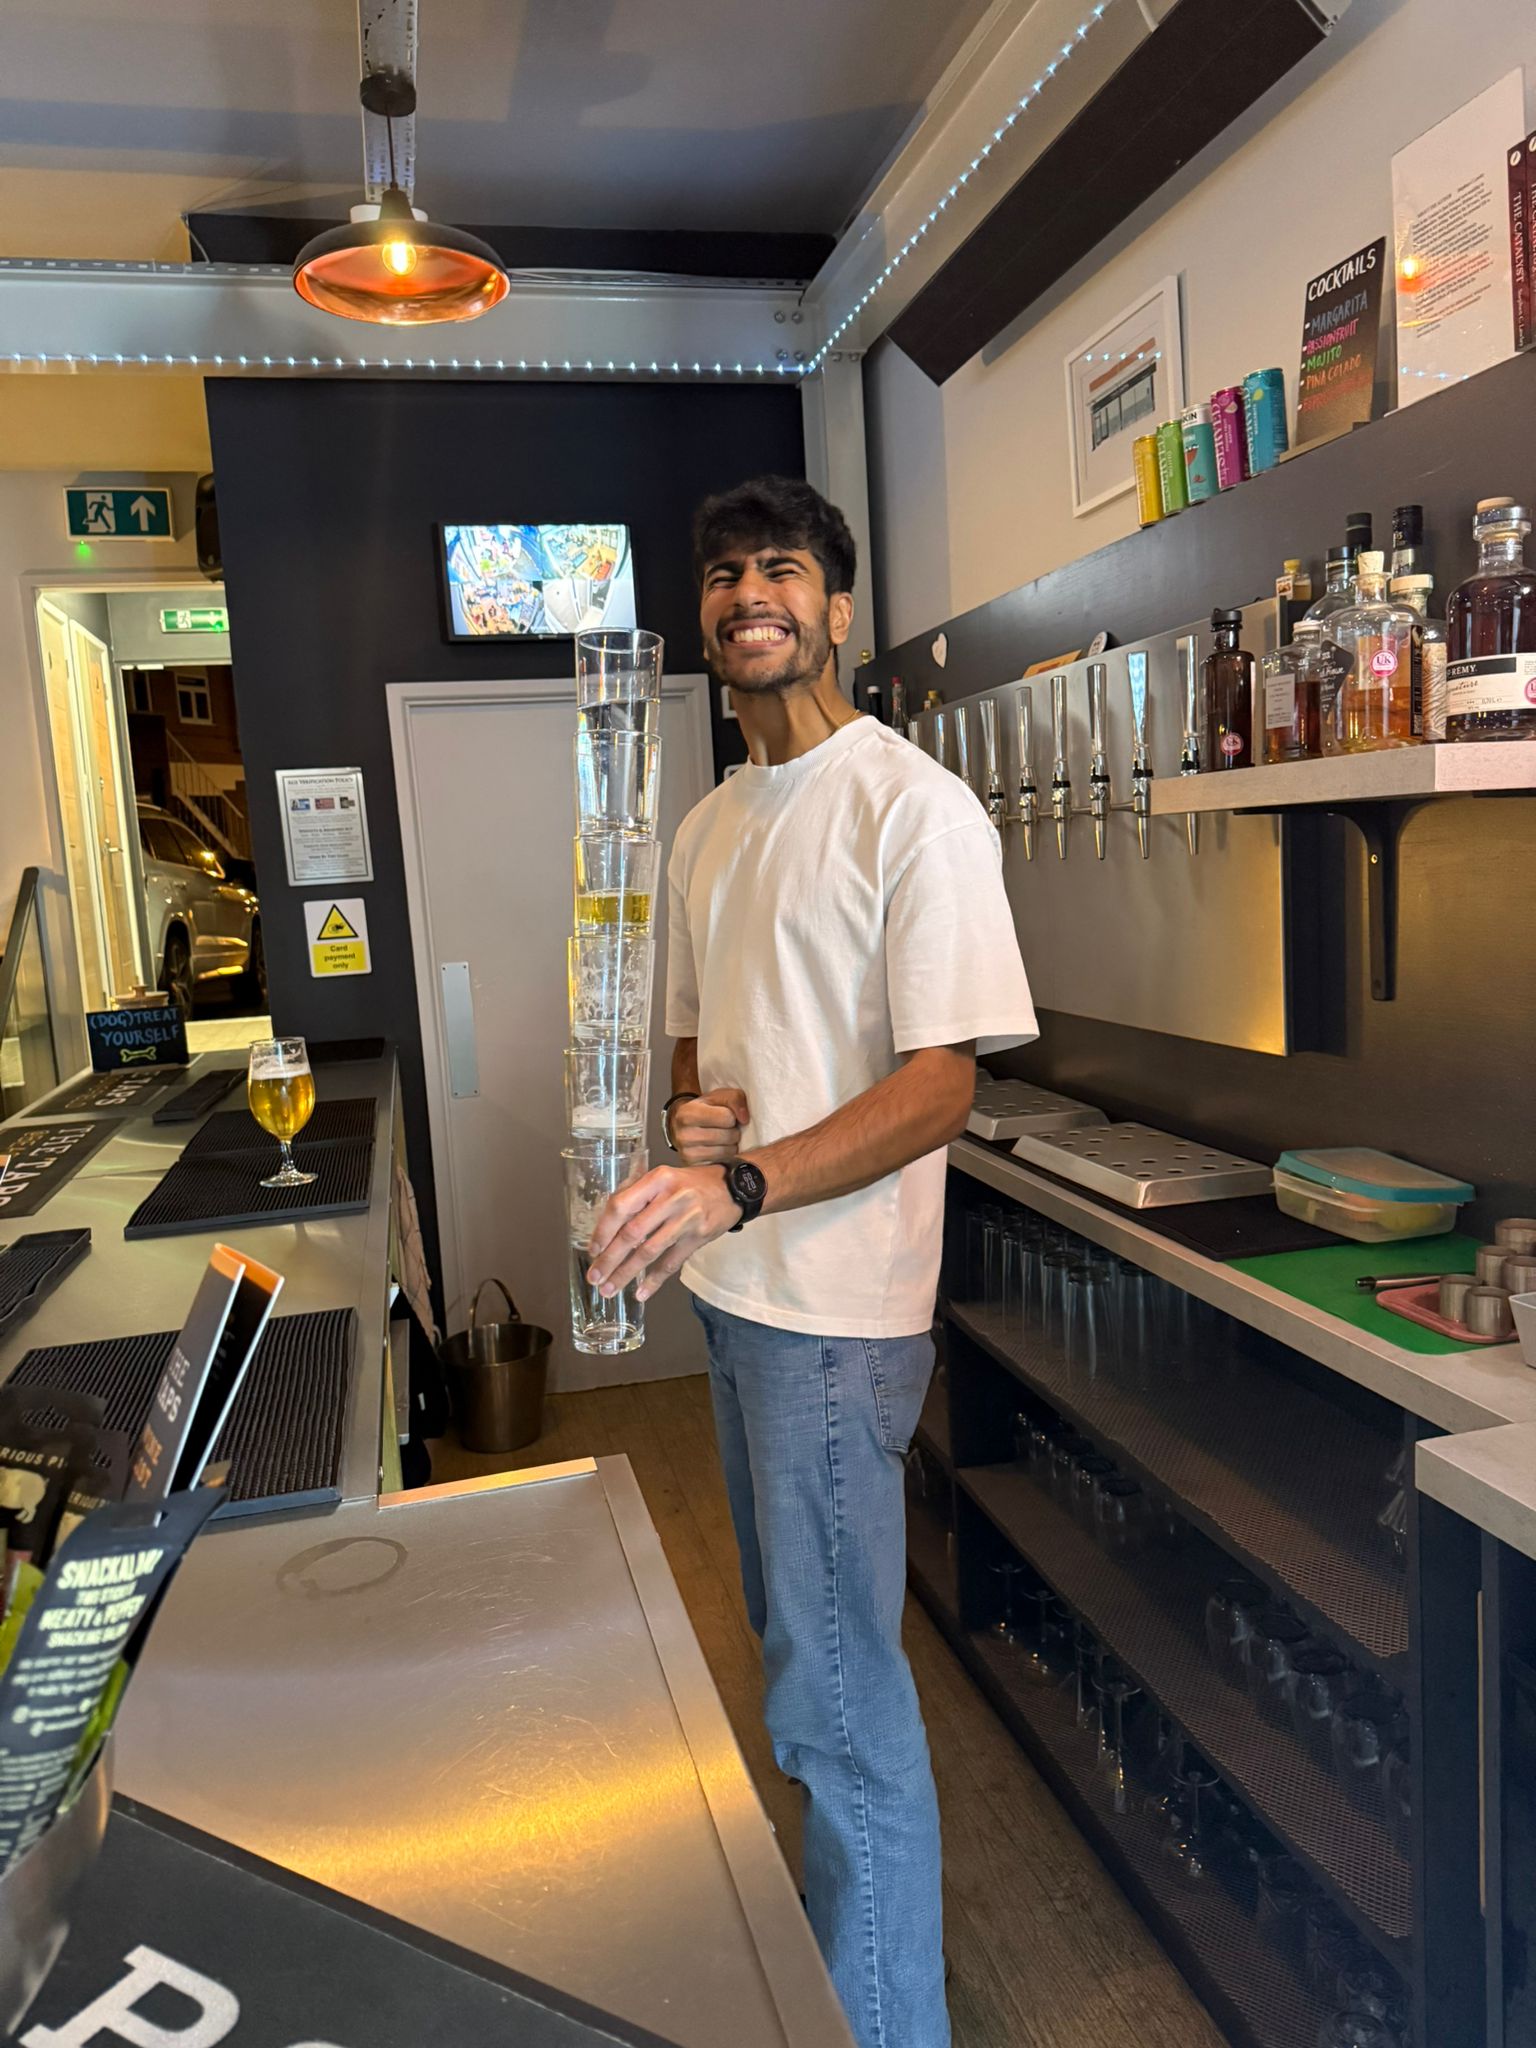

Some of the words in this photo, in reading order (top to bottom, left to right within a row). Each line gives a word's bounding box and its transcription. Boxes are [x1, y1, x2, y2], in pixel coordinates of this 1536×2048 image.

[1512, 192, 1522, 221] THE
[1514, 221, 1525, 283] CATALYST
[1308, 248, 1376, 301] COCKTAILS
[1311, 289, 1368, 336] MARGARITA
[1306, 318, 1359, 354] PASSIONFRUIT
[1307, 345, 1342, 372] MOJITO
[1376, 655, 1391, 665] UK
[324, 954, 355, 962] payment
[101, 1024, 179, 1046] YOURSELF
[29, 1125, 96, 1156] THE
[38, 1606, 97, 1631] MEATY
